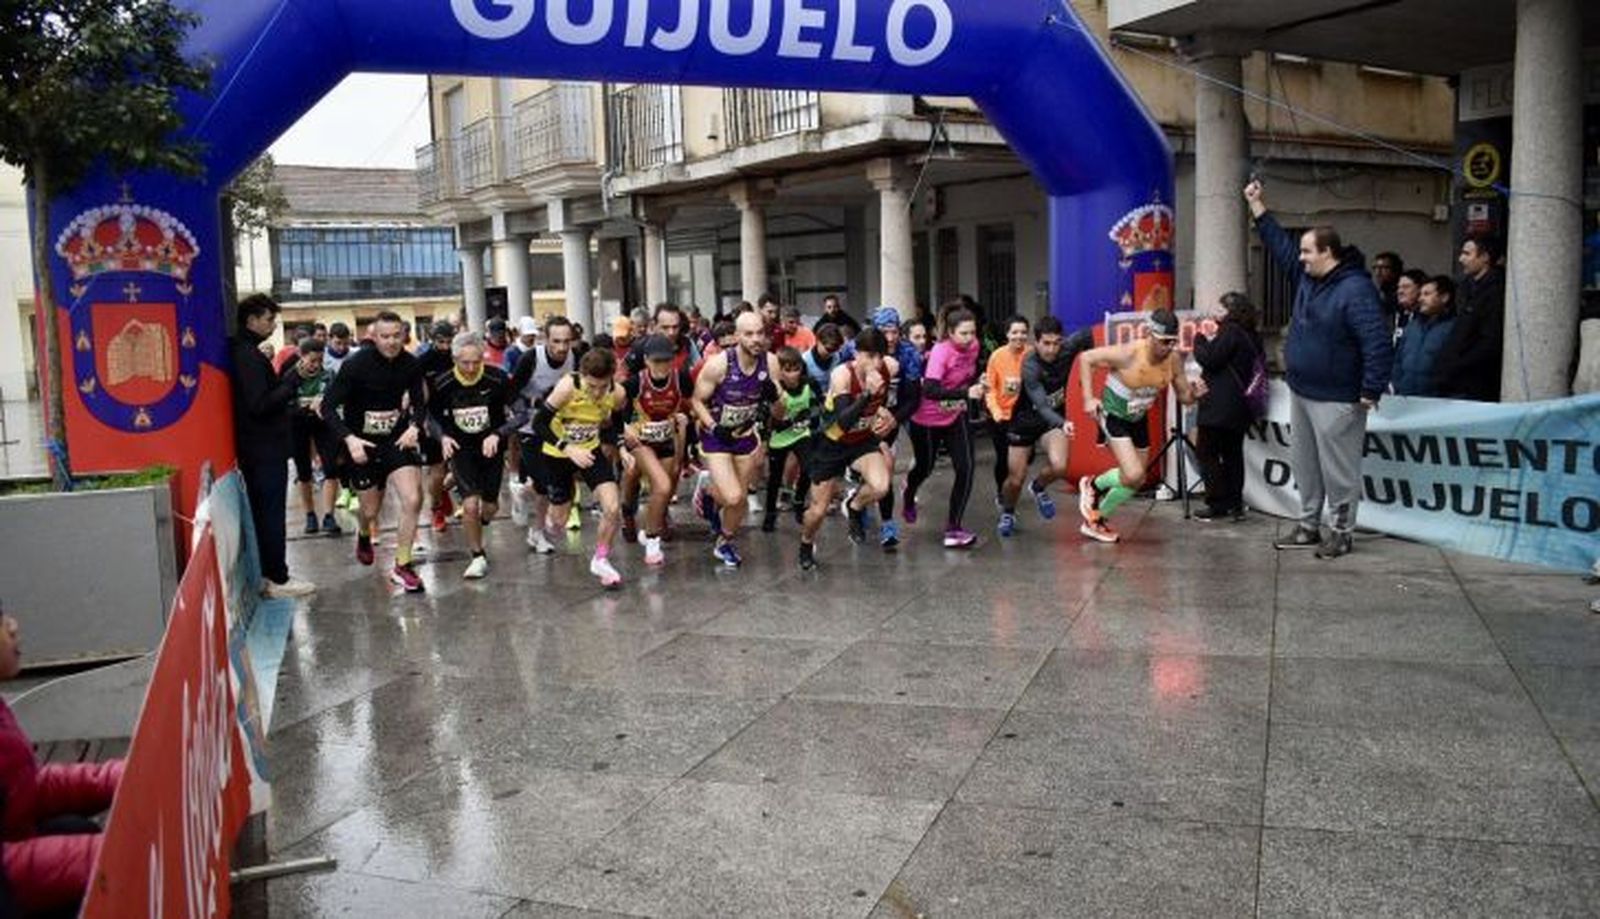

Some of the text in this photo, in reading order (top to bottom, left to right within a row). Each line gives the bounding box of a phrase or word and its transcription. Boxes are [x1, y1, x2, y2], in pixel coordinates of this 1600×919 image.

[450, 0, 954, 66] GUIJUELO
[1264, 459, 1600, 533] D UIJUELO
